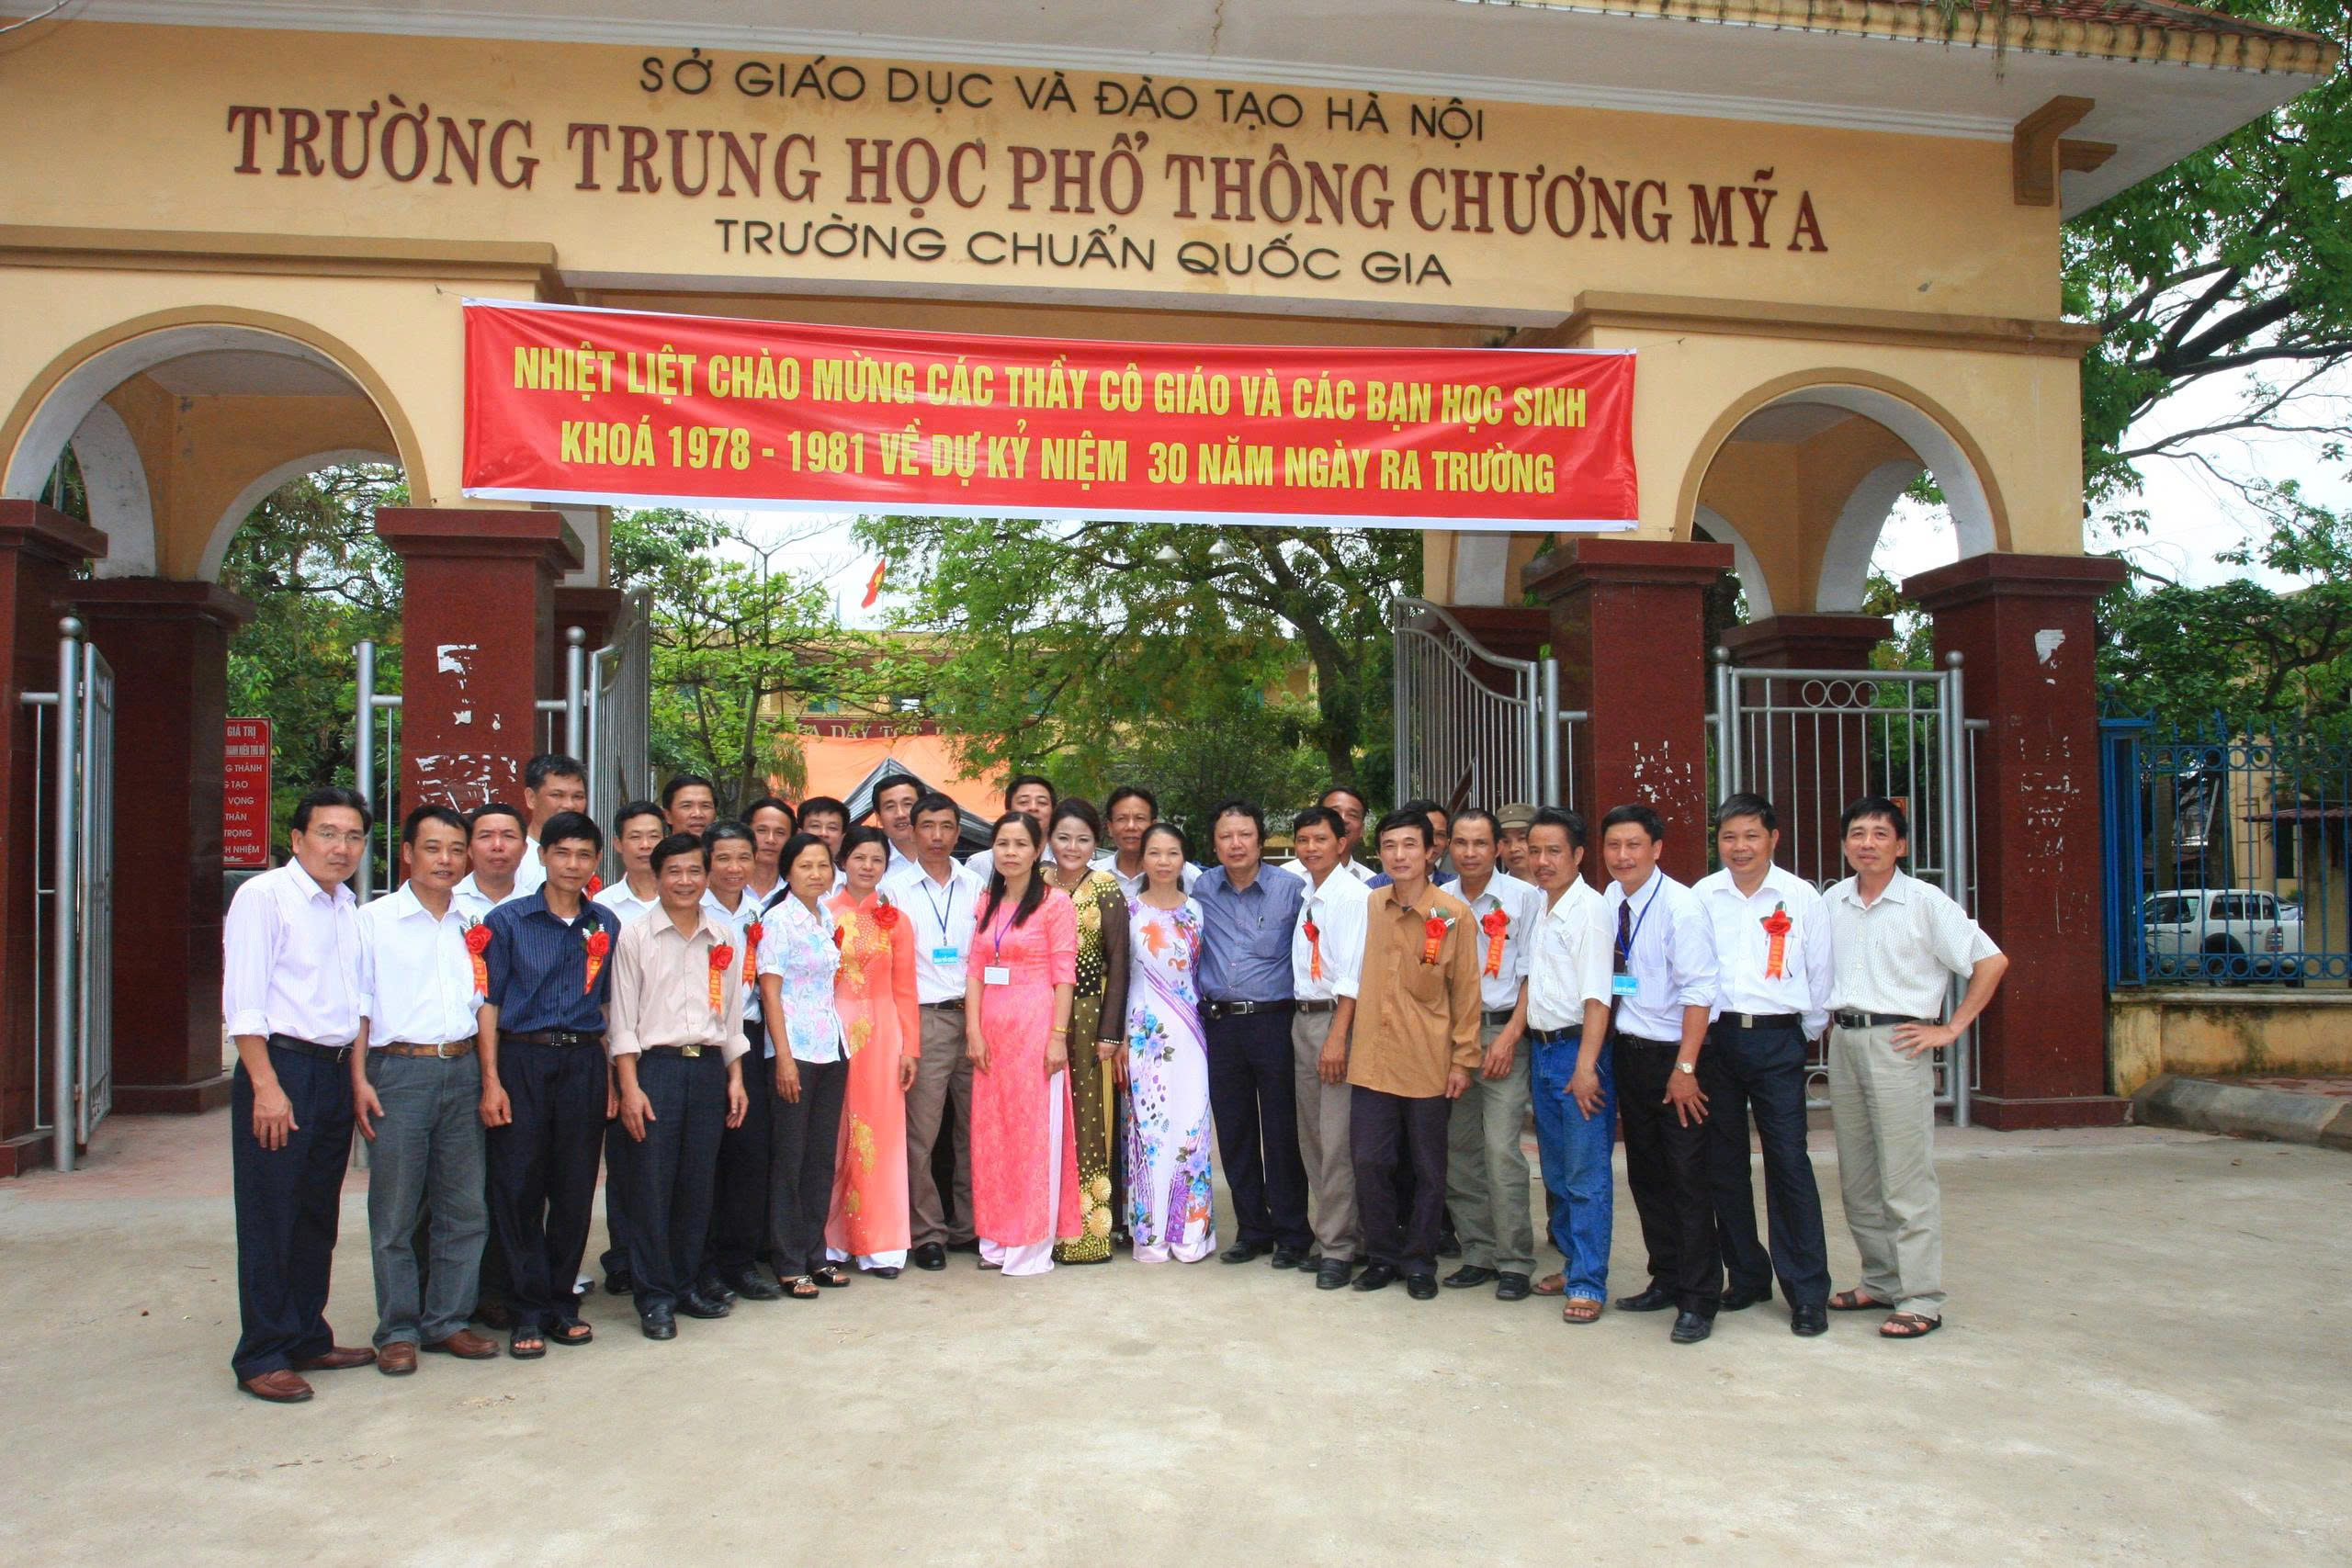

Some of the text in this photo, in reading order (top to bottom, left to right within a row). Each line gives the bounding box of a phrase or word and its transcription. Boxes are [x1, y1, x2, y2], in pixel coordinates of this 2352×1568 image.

[640, 48, 1482, 148] SỞ GIÁO DỤC VÀ ĐÀO TẠO HÀ NỘI
[228, 95, 1828, 253] TRƯỜNG TRUNG HỌC PHỔ THÔNG CHƯƠNG MỸ A
[715, 208, 1452, 286] TRƯỜNG CHUẨN QUỐC GIA
[514, 342, 1586, 434] NHIỆT LIỆT CHÀO MỪNG CÁC THẦY CÔ GIÁO VÀ CÁC BẠN HỌC SINH
[561, 415, 655, 466] KHOÁ
[669, 425, 751, 470] 1978
[788, 431, 864, 474] 1981
[880, 417, 920, 475] VỀ
[933, 432, 981, 486] DỰ
[988, 419, 1030, 479] KỶ
[1041, 431, 1127, 490] NIỆM
[1148, 443, 1187, 483] 30
[1198, 437, 1273, 486] NĂM
[1285, 440, 1370, 489] NGÀY
[1381, 449, 1422, 490] RA
[1432, 441, 1555, 493] TRƯỜNG
